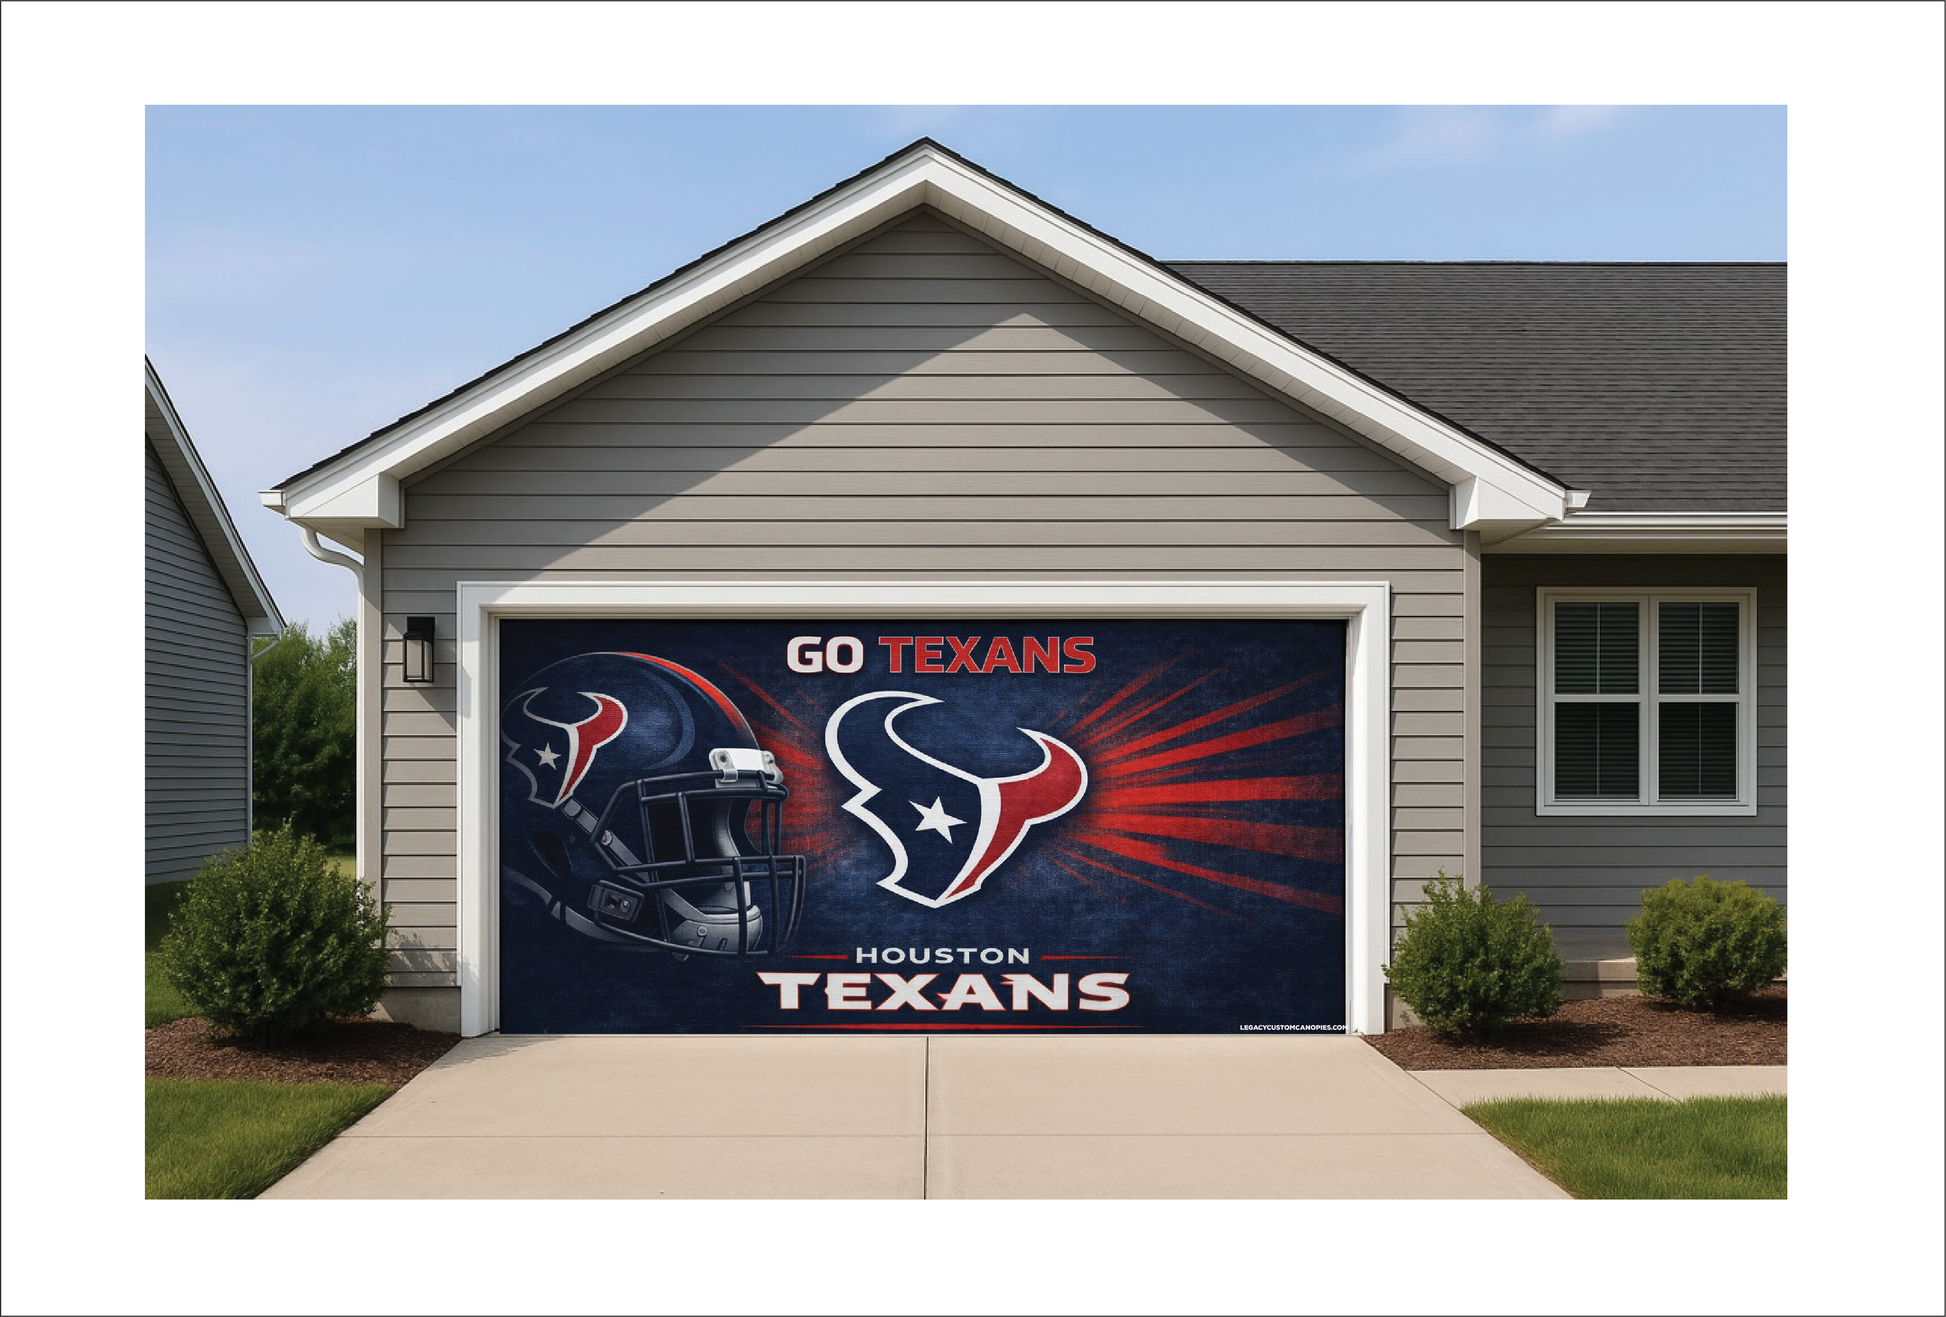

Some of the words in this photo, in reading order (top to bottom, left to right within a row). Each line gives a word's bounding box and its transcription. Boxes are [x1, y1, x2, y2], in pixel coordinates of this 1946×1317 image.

[787, 636, 864, 673] GO
[878, 636, 1096, 673] TEXANS
[855, 947, 1030, 964] HOUSTON
[755, 972, 1131, 1011] TEXANS
